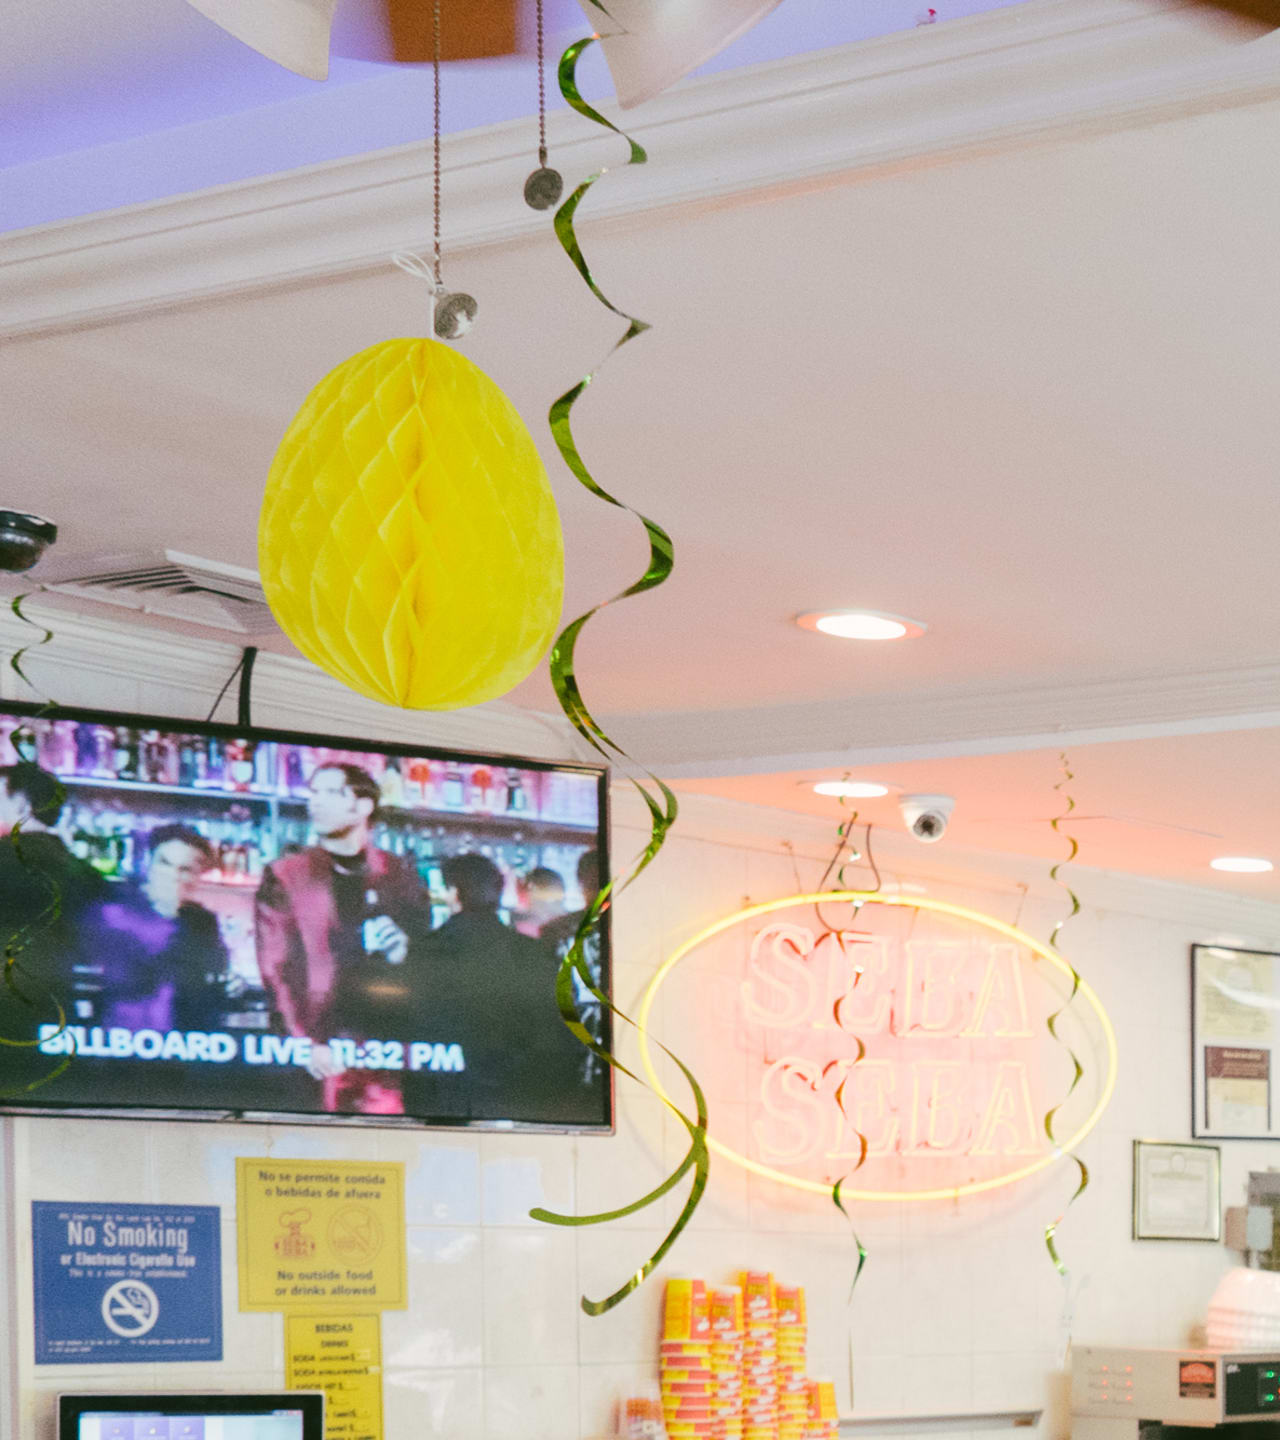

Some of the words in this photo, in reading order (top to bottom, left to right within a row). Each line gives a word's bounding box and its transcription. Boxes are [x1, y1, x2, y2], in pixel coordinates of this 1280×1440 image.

[741, 921, 1034, 1039] SEBA
[37, 1023, 235, 1062] BILLBOARD
[243, 1033, 312, 1066] LIVE
[330, 1038, 404, 1070] 11:32
[410, 1041, 465, 1072] PM
[753, 1055, 1047, 1165] SEBA
[258, 1170, 275, 1181] No
[279, 1173, 291, 1181] se
[295, 1172, 340, 1184] permite
[345, 1174, 386, 1184] comida
[265, 1188, 272, 1196] o
[276, 1187, 321, 1198] bebidas
[326, 1188, 340, 1198] de
[345, 1188, 381, 1199] afuera
[68, 1222, 96, 1246] No
[104, 1221, 188, 1254] Smoking
[60, 1254, 73, 1266] or
[75, 1252, 127, 1267] Electronic
[129, 1253, 174, 1269] Cigarette
[277, 1271, 294, 1280] No
[298, 1270, 340, 1280] outside
[346, 1270, 373, 1280] food
[275, 1287, 286, 1296] or
[291, 1286, 325, 1295] drinks
[330, 1285, 376, 1295] allowed
[315, 1324, 353, 1333] BEBIDAS
